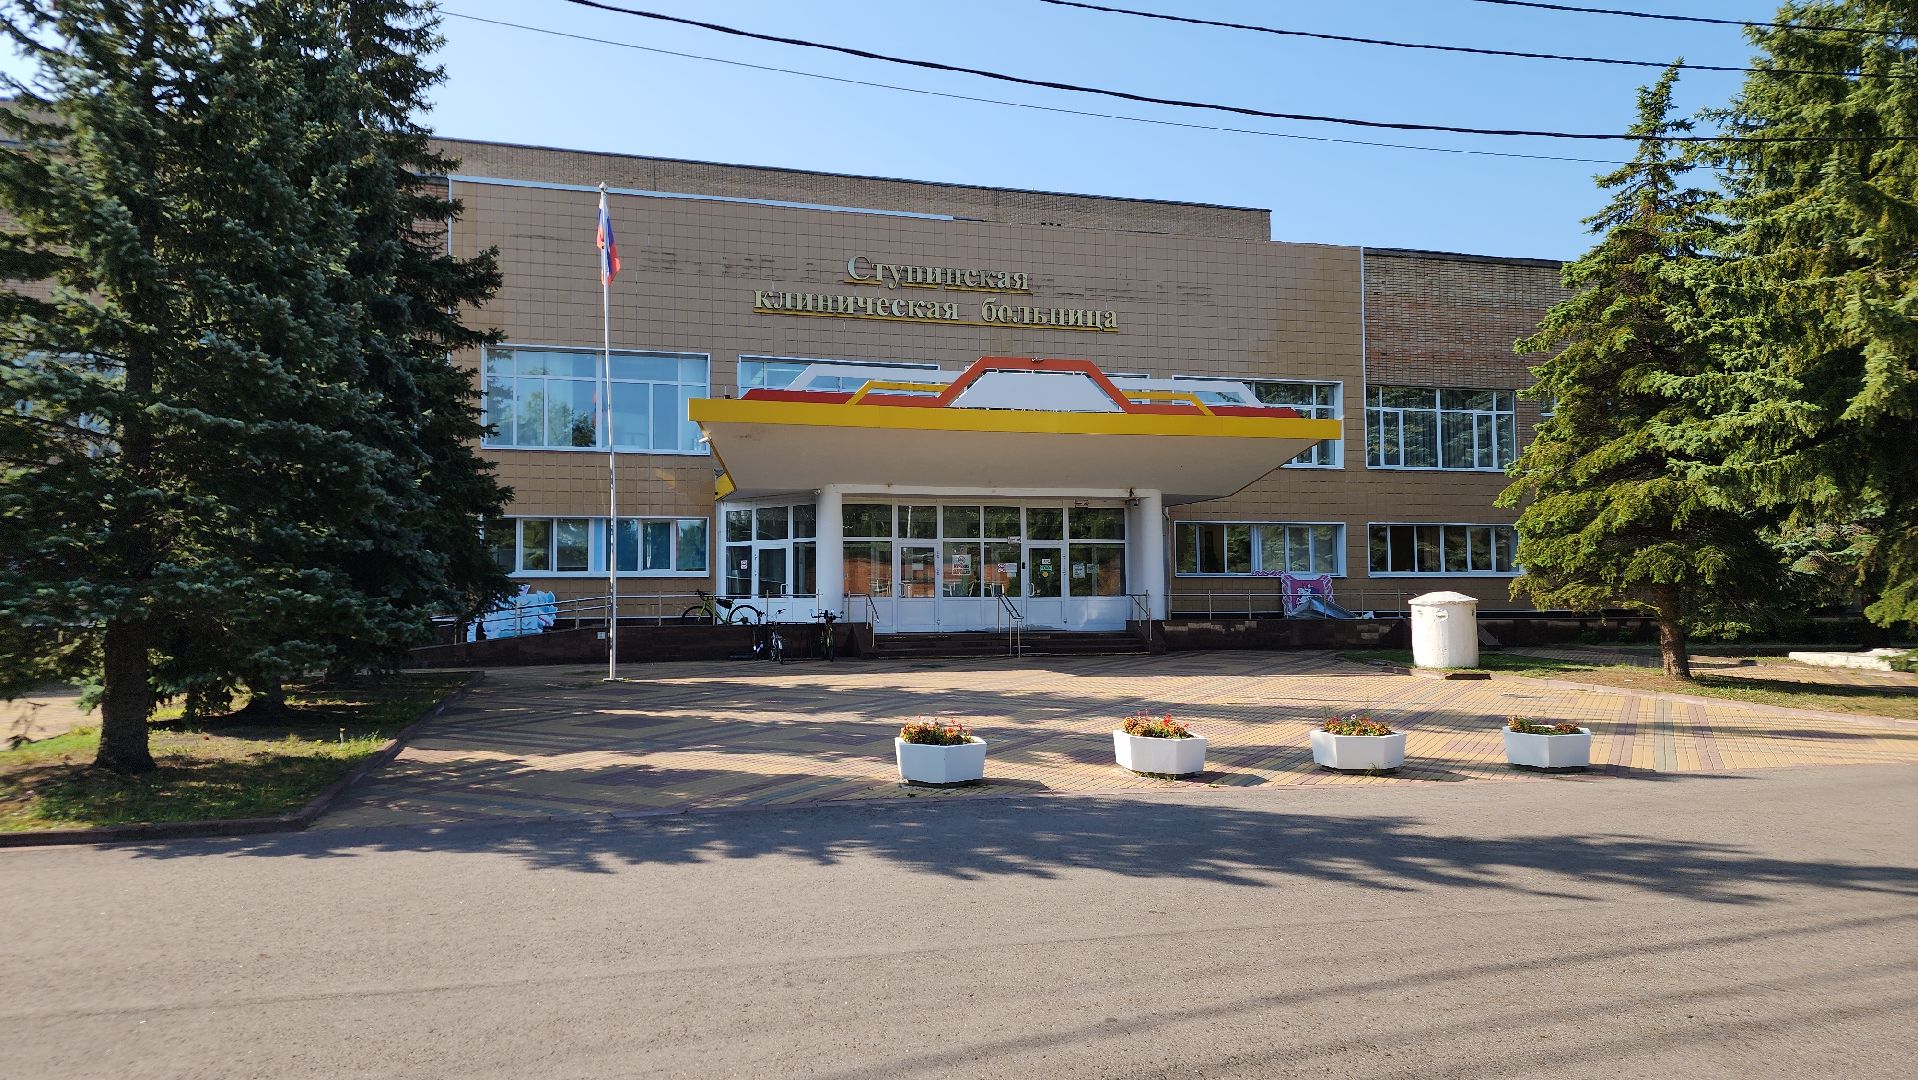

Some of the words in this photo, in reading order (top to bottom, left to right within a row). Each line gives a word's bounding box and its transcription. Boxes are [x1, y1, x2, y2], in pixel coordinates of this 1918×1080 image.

[847, 255, 1029, 290] Ступинская
[754, 289, 960, 320] клиническая
[981, 297, 1118, 330] больница
